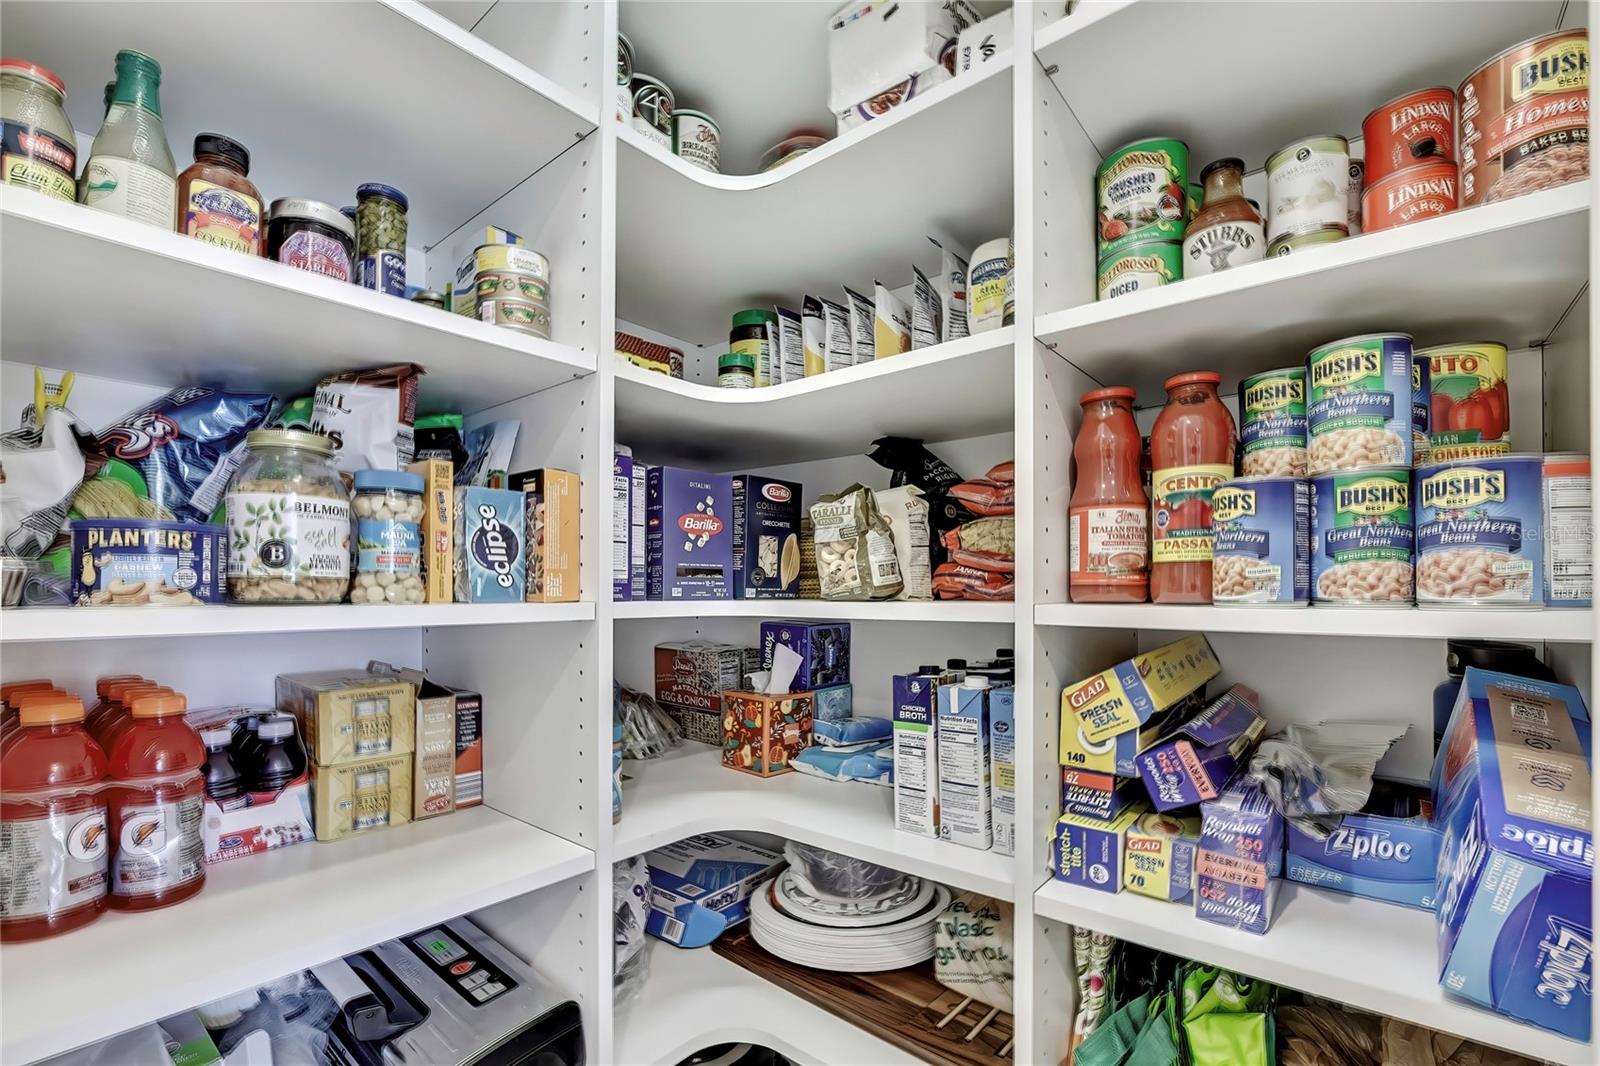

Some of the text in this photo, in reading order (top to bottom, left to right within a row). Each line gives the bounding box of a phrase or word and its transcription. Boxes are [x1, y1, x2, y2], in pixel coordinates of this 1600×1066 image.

[1390, 101, 1453, 134] LINDSAY
[1403, 120, 1445, 141] LARGE
[1520, 130, 1568, 156] BAKED
[10, 163, 48, 184] Clam
[1107, 172, 1156, 196] CRUSHED
[1111, 185, 1153, 205] TOMATOES
[1388, 177, 1456, 215] LINDSAY
[1401, 200, 1447, 221] LARGE
[1190, 226, 1256, 260] STUBB'S
[290, 258, 347, 281] STARLING
[1110, 280, 1139, 299] DICED
[1313, 351, 1378, 384] BUSH'S
[1431, 354, 1478, 374] NTO
[1246, 380, 1301, 410] BUSH'S
[1331, 393, 1390, 406] Northern
[1327, 407, 1358, 419] Beans
[1258, 428, 1285, 438] Beans
[1431, 434, 1459, 445] LIAN
[689, 481, 712, 490] DITALINI
[1166, 476, 1222, 492] CENTO
[1425, 474, 1500, 502] BUSH'S
[769, 488, 790, 499] Barilla
[1214, 492, 1254, 511] USH'S
[1339, 486, 1408, 508] BUSH'S
[294, 501, 349, 518] BELMONT
[812, 505, 851, 520] TARALLI
[684, 517, 719, 531] Barilla
[1091, 526, 1125, 534] ITALIAN
[1172, 529, 1214, 537] TRADITIONA
[1447, 518, 1517, 534] Northern
[88, 527, 193, 551] PLANTERS
[381, 531, 415, 541] MAUNA
[1219, 530, 1265, 543] Northern
[1328, 524, 1413, 543] Great Northern
[1359, 536, 1392, 547] Beans
[1441, 533, 1477, 544] Beans
[477, 503, 515, 588] eclipse
[1338, 552, 1379, 562] REDUCED
[763, 632, 774, 672] leenex
[661, 690, 711, 707] EGG & ONION
[1070, 679, 1106, 709] GLAD
[899, 711, 927, 720] BROTH
[963, 717, 978, 725] Facts
[1091, 712, 1121, 729] SEAL
[1067, 751, 1086, 764] 140
[1066, 774, 1081, 785] 75
[1068, 785, 1112, 799] WAX PAPER
[1074, 804, 1112, 819] Reynolds
[1205, 815, 1264, 835] Reynolds
[1128, 839, 1161, 850] GLAD
[1203, 826, 1263, 852] Wrap 250
[1333, 827, 1412, 864] Ziploc
[1503, 823, 1592, 867] ploc
[1130, 873, 1145, 887] 70
[1290, 866, 1344, 884] FREEZER
[1490, 861, 1525, 915] FREEZER
[1201, 900, 1258, 924] Reynolds
[1226, 896, 1262, 914] Wrap
[1536, 927, 1593, 1007] Ziploc
